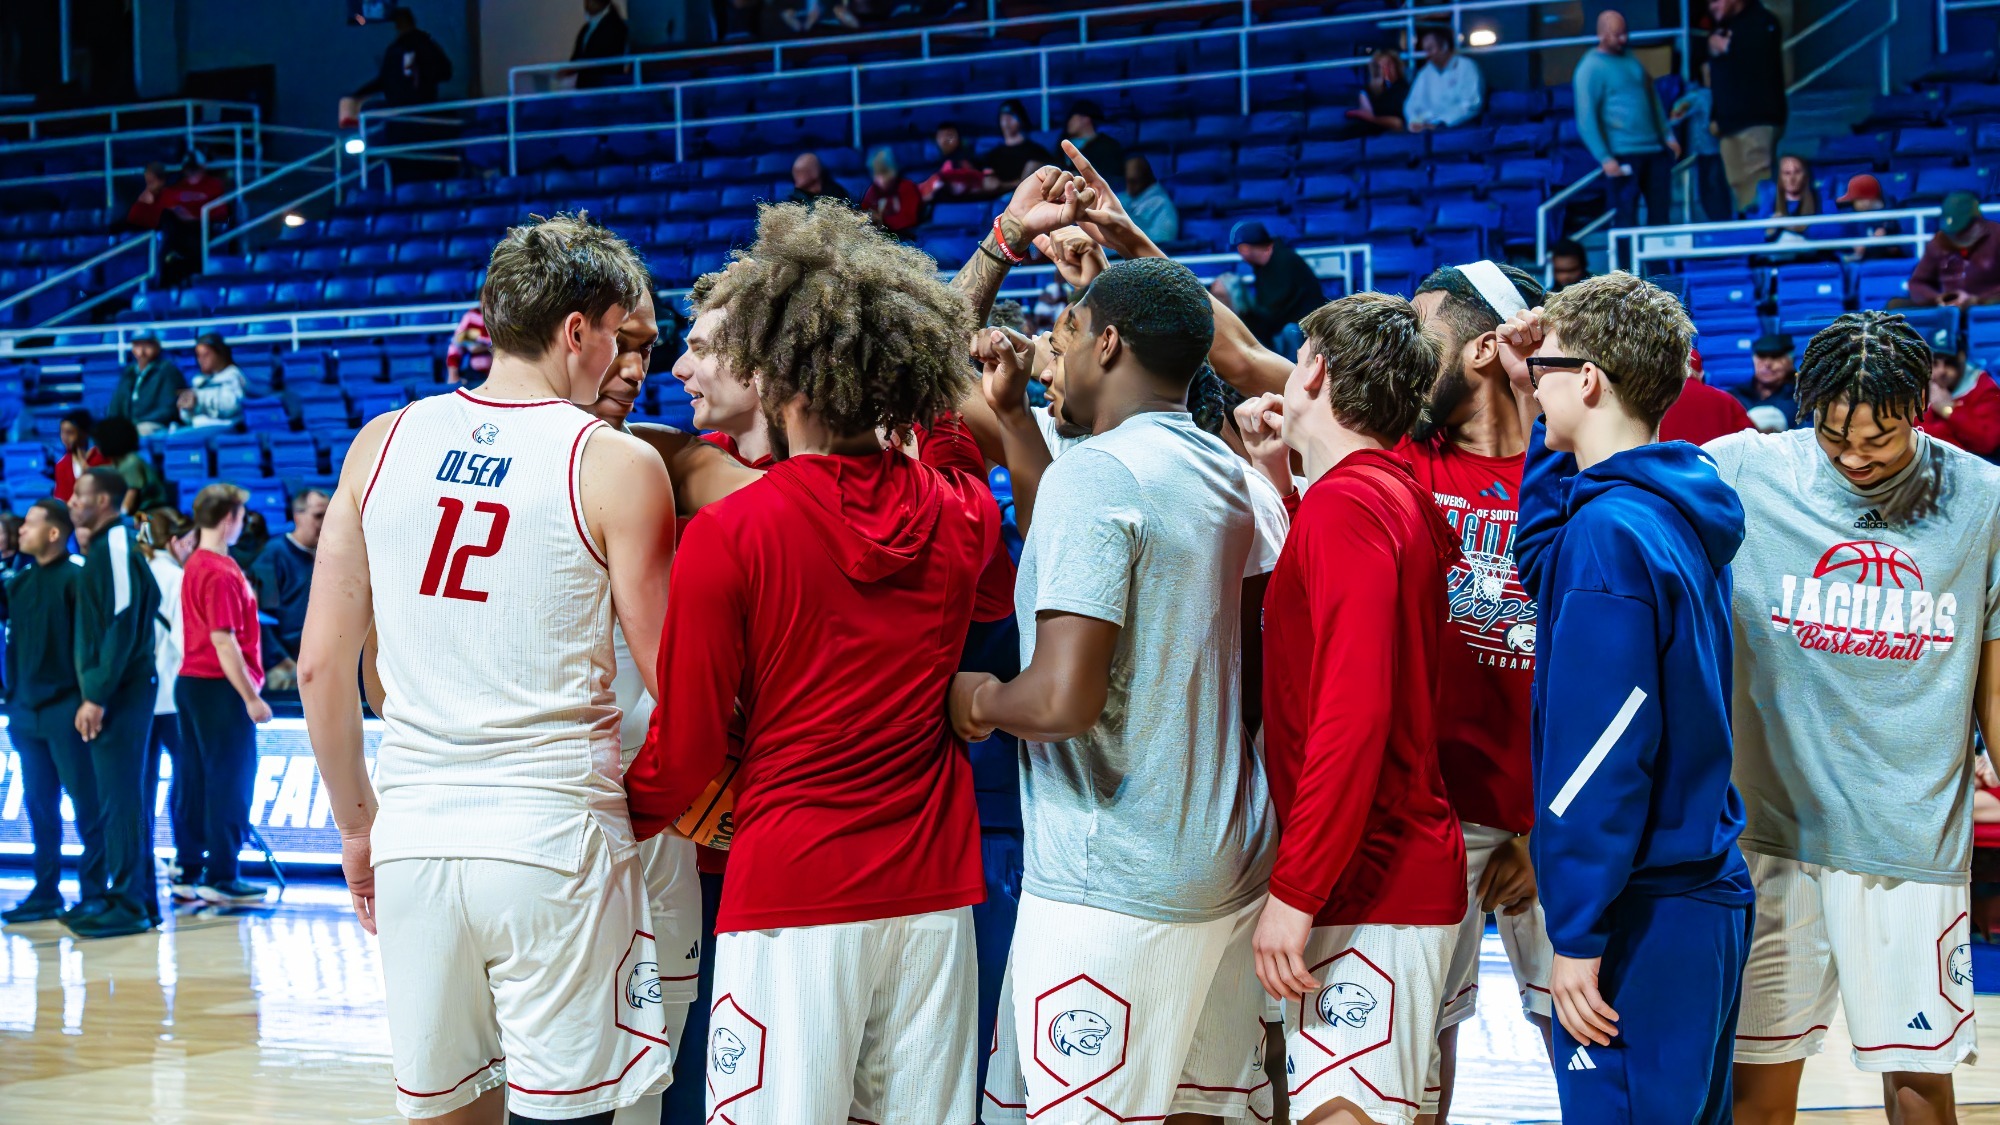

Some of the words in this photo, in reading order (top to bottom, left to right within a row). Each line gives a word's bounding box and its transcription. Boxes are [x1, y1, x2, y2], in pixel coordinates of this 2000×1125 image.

[436, 450, 512, 487] OLSEN
[1477, 509, 1489, 519] OF
[1853, 519, 1888, 529] adidas
[419, 496, 510, 602] 12
[1771, 574, 1957, 652] JAGUARS
[1795, 622, 1927, 661] Basketball
[1474, 651, 1536, 670] LABAM
